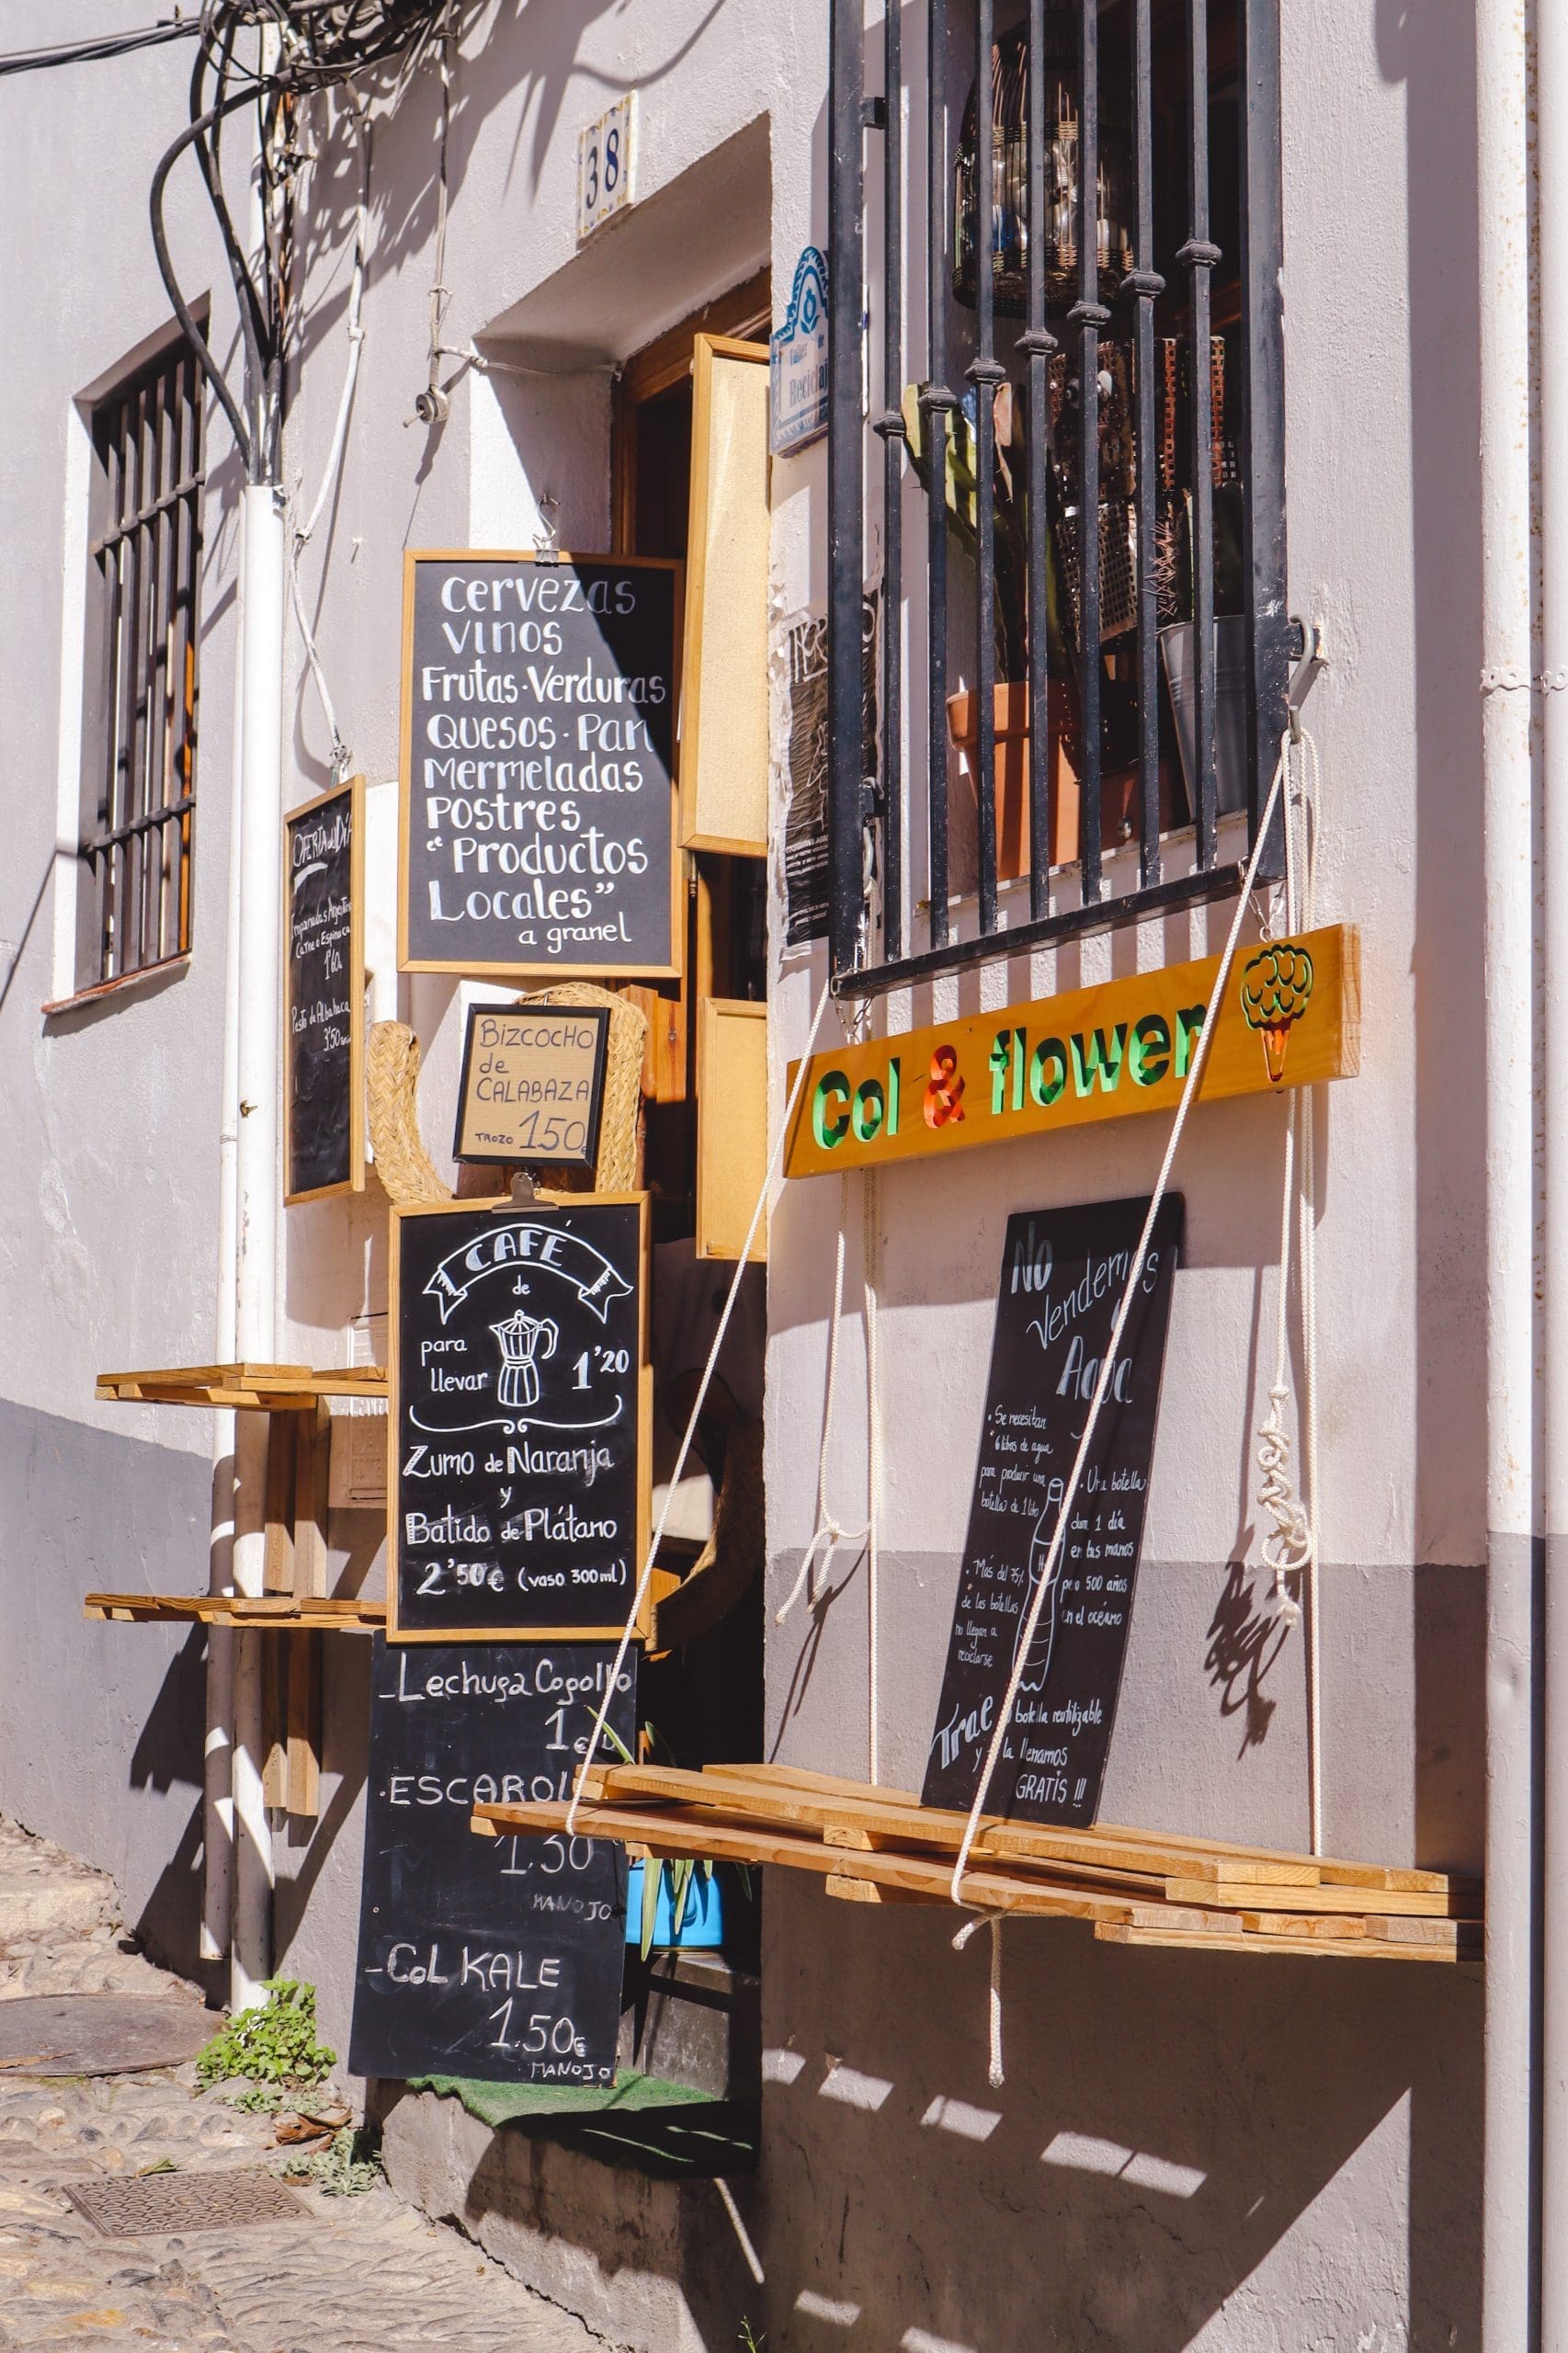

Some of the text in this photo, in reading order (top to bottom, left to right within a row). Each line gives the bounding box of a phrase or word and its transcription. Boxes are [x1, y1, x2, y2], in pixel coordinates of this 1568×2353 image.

[586, 129, 619, 210] 38
[790, 358, 828, 408] Reciclaj
[577, 713, 654, 753] Pan
[423, 752, 643, 793] Mermeladas
[518, 913, 632, 954] a granel
[479, 1052, 509, 1074] de
[812, 1003, 1206, 1150] Col & flower
[476, 1077, 590, 1103] CALABAZA
[475, 1132, 514, 1144] TROZO
[464, 1220, 571, 1270] CAFÉ
[1011, 1222, 1052, 1294] No
[512, 1275, 530, 1296] de
[421, 1338, 467, 1367] para
[430, 1368, 488, 1392] llevar
[994, 1404, 1006, 1426] Se
[403, 1446, 475, 1477] Zumo
[484, 1458, 504, 1473] de
[506, 1440, 615, 1486] Naranja
[1020, 1438, 1028, 1452] de
[1031, 1442, 1053, 1464] agua
[979, 1466, 996, 1489] para
[999, 1463, 1029, 1495] producir
[1111, 1468, 1146, 1491] botella
[499, 1486, 512, 1508] y
[981, 1491, 1007, 1512] botella
[406, 1504, 618, 1545] Batido de Plátano
[1095, 1515, 1101, 1531] 1
[1108, 1509, 1126, 1530] día
[1105, 1541, 1134, 1557] manos
[997, 1563, 1008, 1581] del
[1086, 1575, 1103, 1591] 500
[1106, 1574, 1127, 1593] años
[961, 1596, 971, 1608] de
[1075, 1605, 1085, 1625] el
[955, 1623, 963, 1636] no
[990, 1627, 997, 1637] a
[928, 1696, 994, 1769] Trae
[1016, 1699, 1048, 1723] botella
[1052, 1699, 1102, 1736] reutilizable
[972, 1747, 983, 1773] y
[391, 1773, 568, 1805] ESCAROL
[460, 1945, 562, 1993] KALE
[531, 2061, 611, 2080] MANOJO
